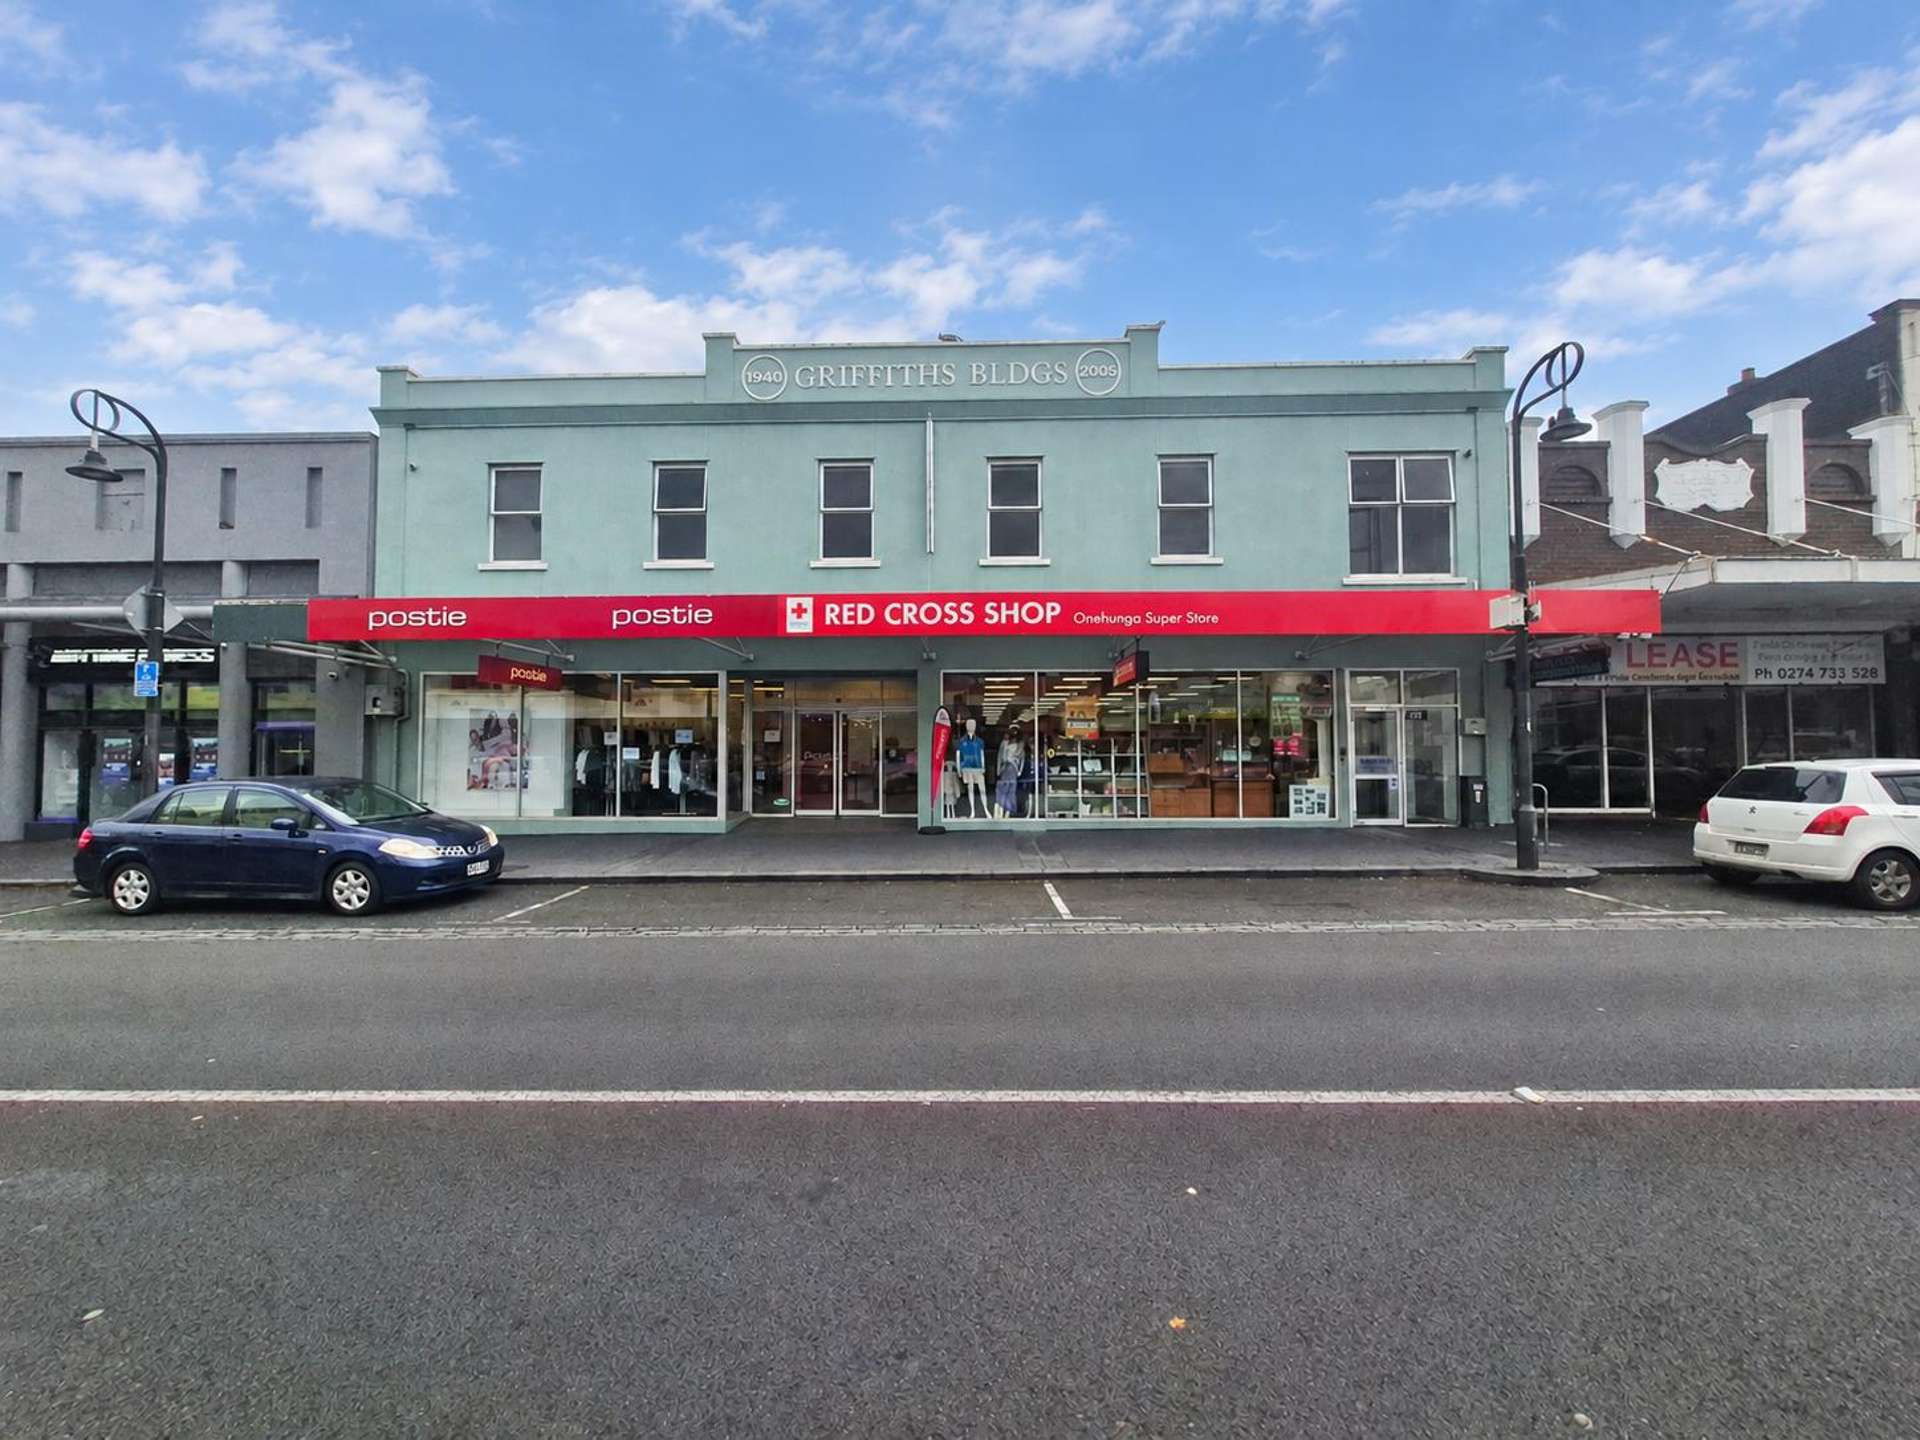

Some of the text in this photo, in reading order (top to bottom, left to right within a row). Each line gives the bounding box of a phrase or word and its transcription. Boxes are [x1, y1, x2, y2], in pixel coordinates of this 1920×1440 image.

[745, 369, 783, 384] 1940
[794, 361, 1068, 389] GRIFFITHS BLDGS
[1079, 363, 1118, 378] 2005
[368, 606, 468, 631] postie
[612, 603, 714, 629] postie
[823, 601, 1062, 626] RED CROSS SHOP
[1073, 611, 1220, 627] Onehunga Super Store
[1625, 641, 1739, 669] LEASE
[510, 666, 548, 683] postie
[1754, 667, 1773, 680] Ph
[1777, 667, 1815, 680] 0274
[1819, 667, 1847, 680] 733
[1851, 667, 1880, 680] 528
